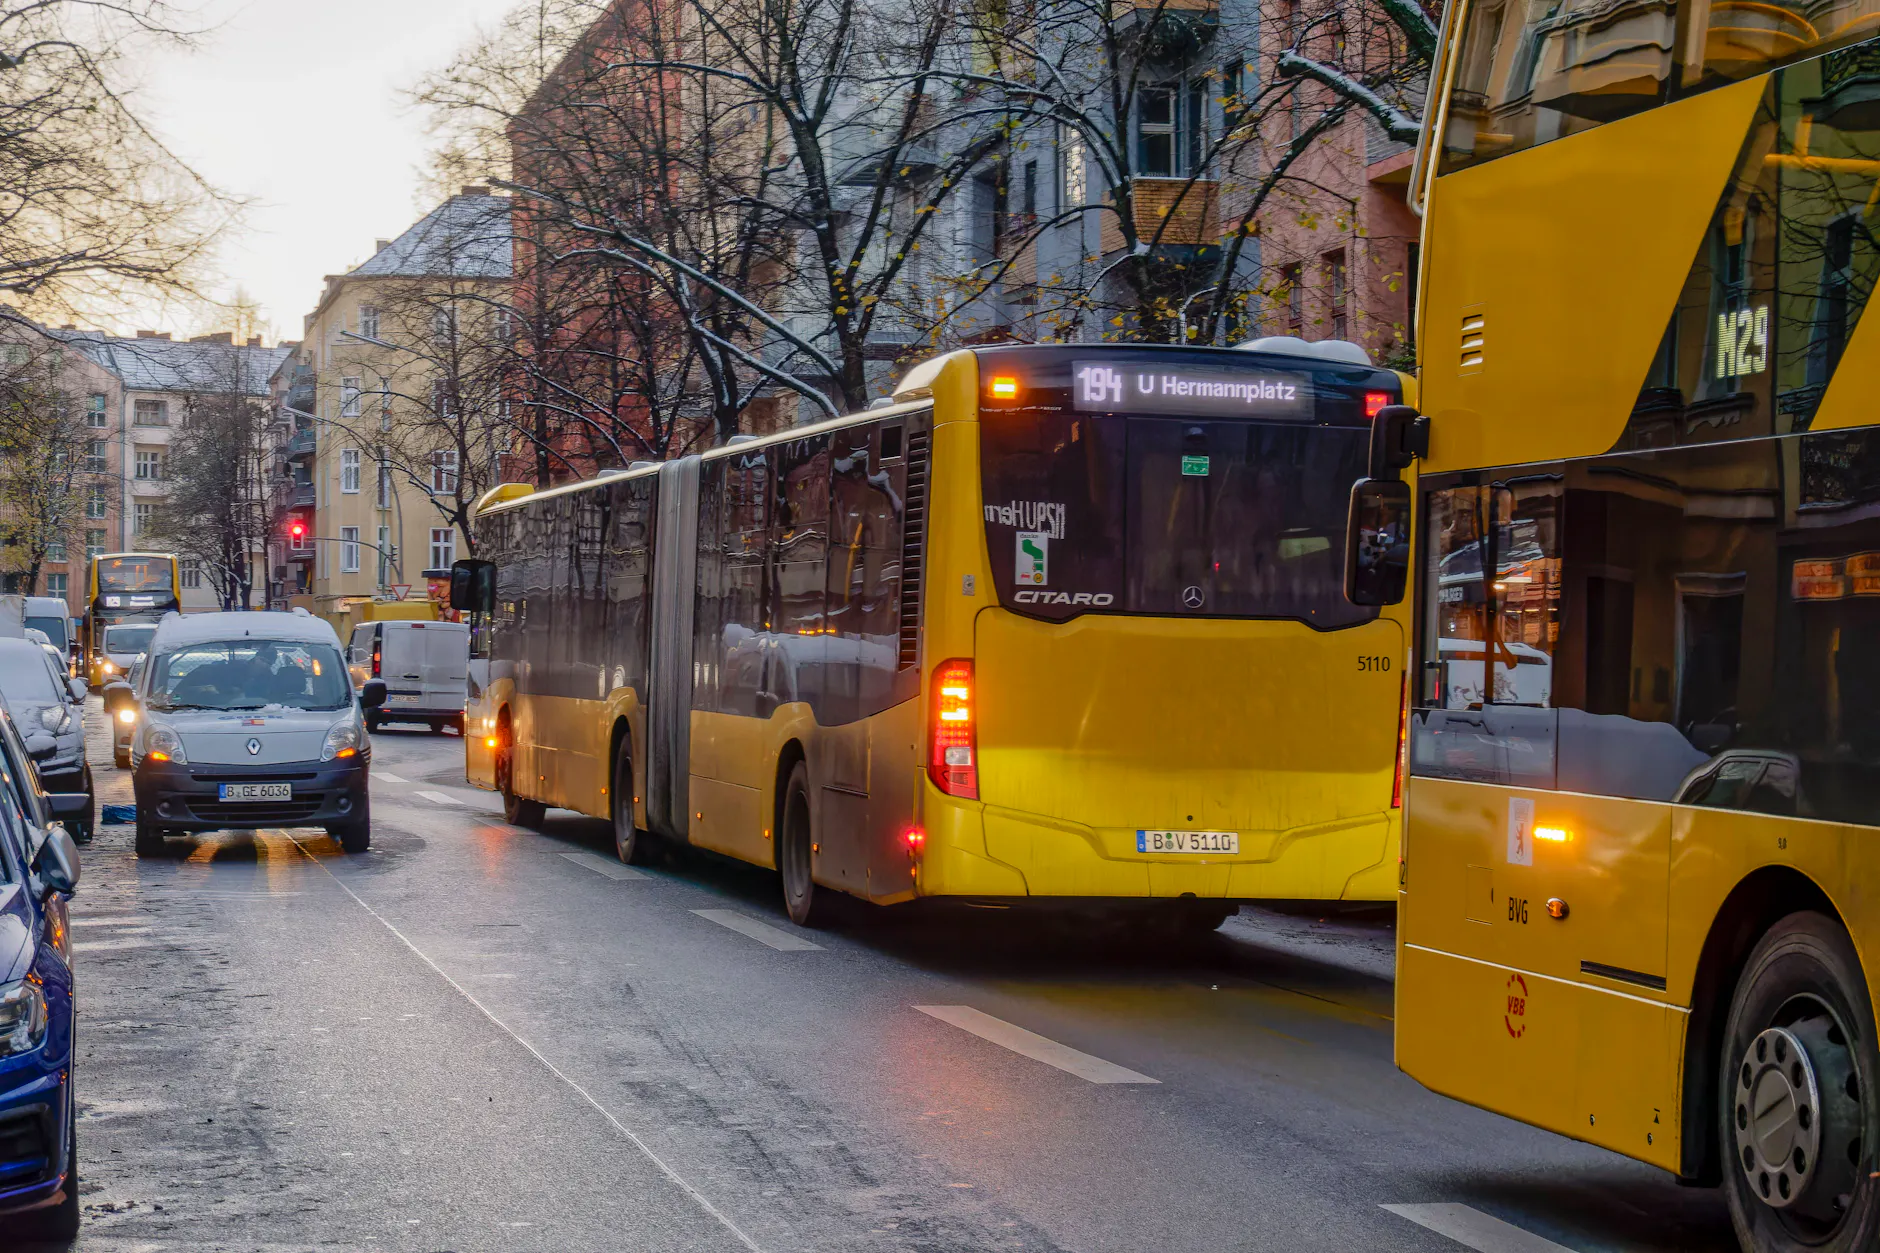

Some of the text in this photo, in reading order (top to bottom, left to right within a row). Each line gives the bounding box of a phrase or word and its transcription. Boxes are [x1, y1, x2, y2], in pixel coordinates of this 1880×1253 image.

[1716, 306, 1768, 378] M29
[1077, 367, 1296, 403] 194 U Hermannplatz
[1014, 590, 1114, 606] CITARO
[1357, 656, 1390, 671] 5110
[227, 785, 289, 797] B GE 6036
[1153, 833, 1231, 851] B V 5110
[1508, 897, 1528, 925] BVG
[1507, 995, 1525, 1017] VBB
